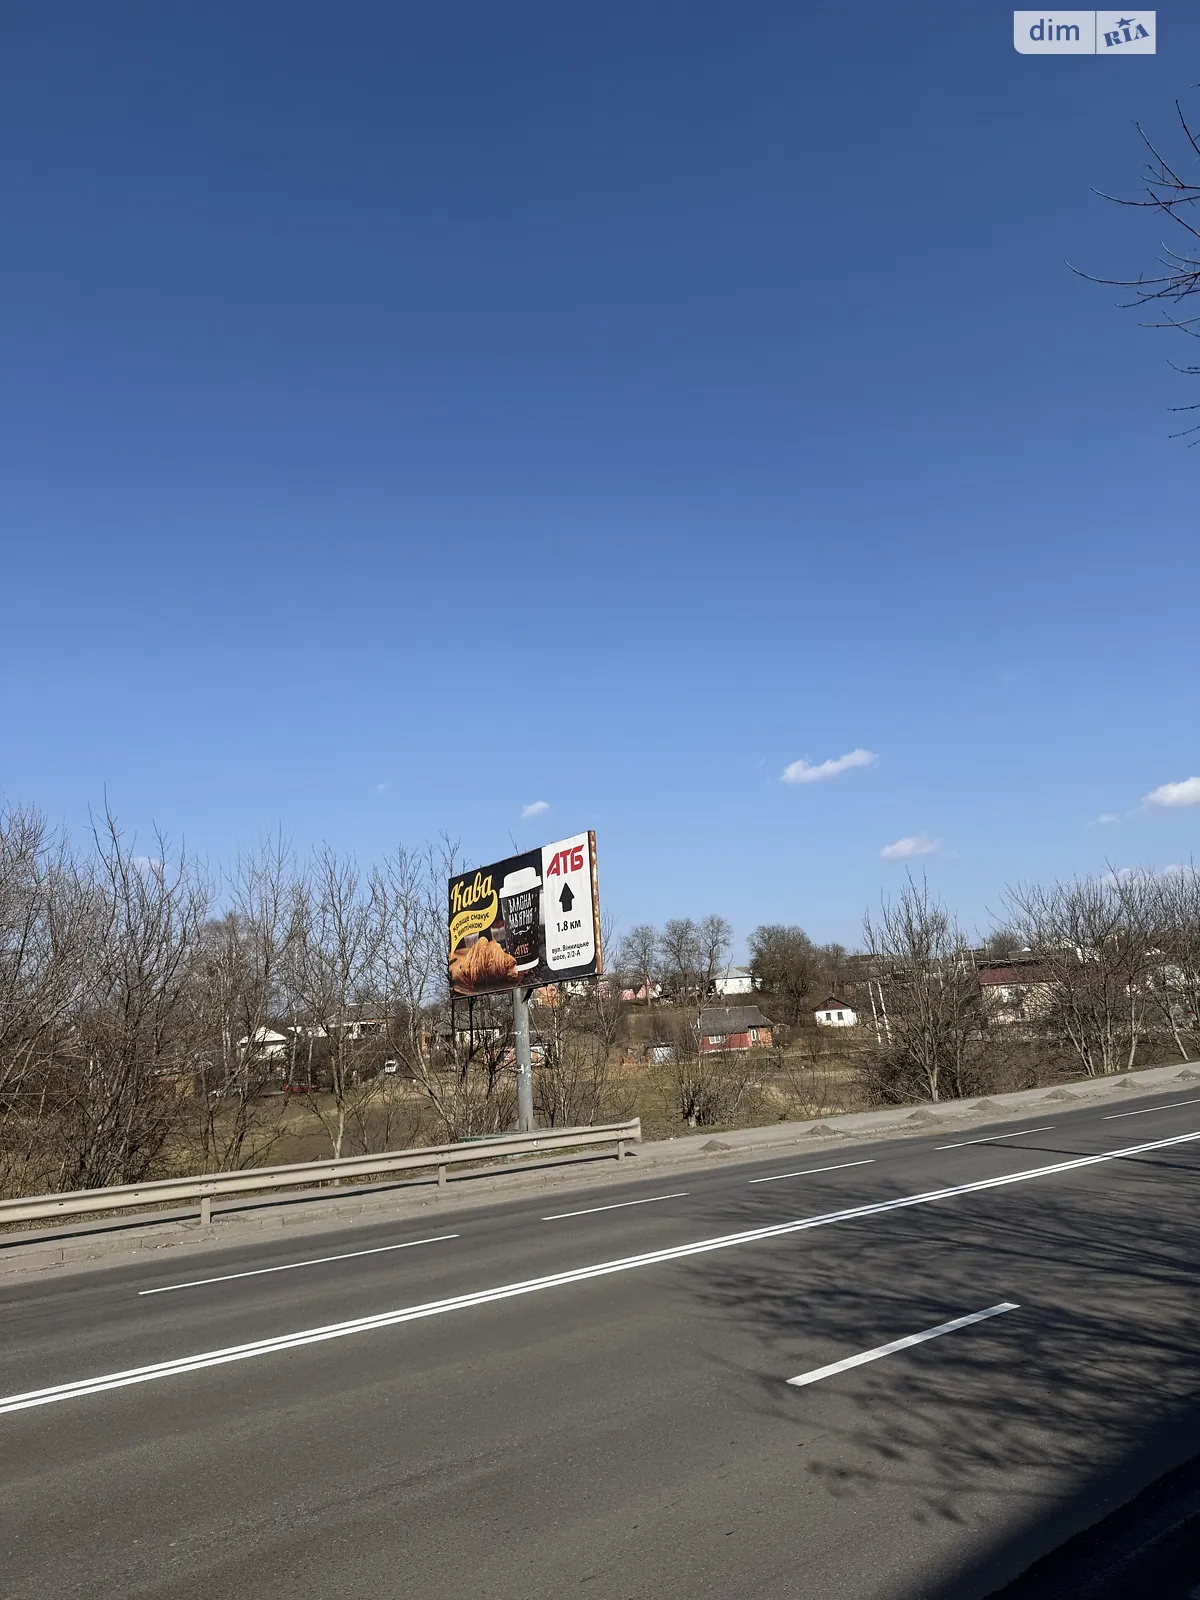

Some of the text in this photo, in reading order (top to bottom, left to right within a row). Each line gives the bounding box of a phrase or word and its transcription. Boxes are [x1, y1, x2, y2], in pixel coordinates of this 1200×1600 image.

[546, 844, 585, 878] АТБ
[451, 872, 492, 913] Кава
[556, 920, 569, 933] 1.8
